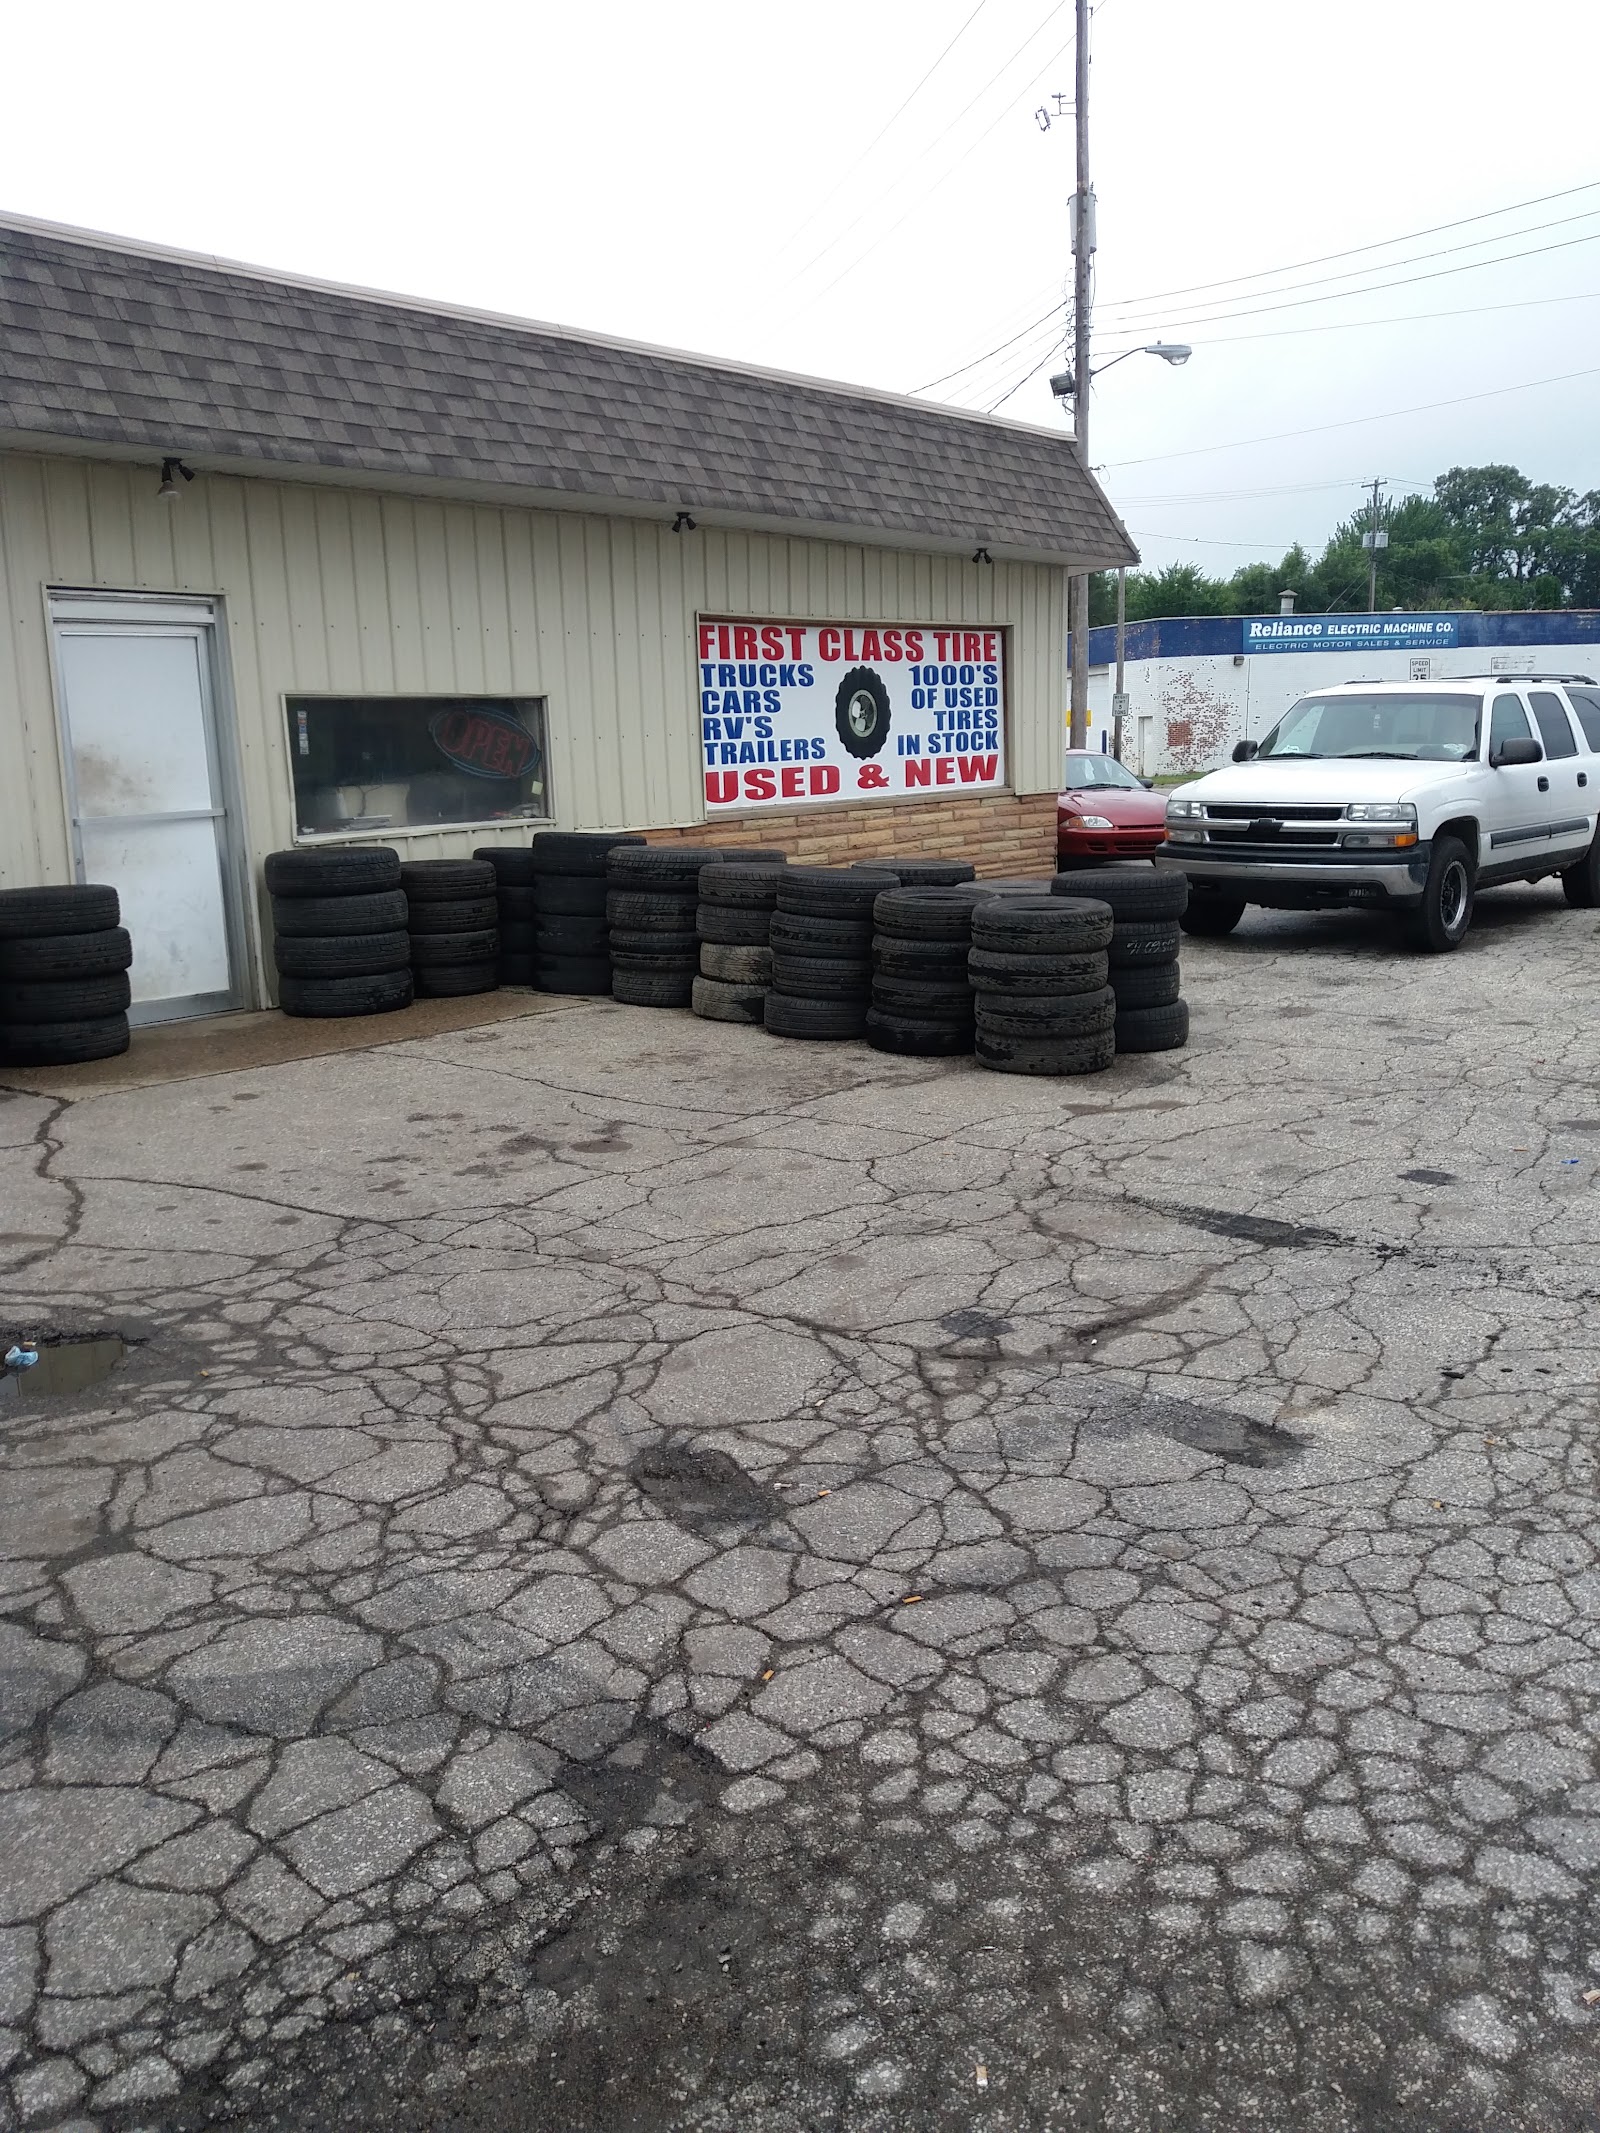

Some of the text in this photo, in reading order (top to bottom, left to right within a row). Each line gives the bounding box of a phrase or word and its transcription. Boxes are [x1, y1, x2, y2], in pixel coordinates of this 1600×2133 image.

[1249, 621, 1454, 637] Reliance ELECTRIC MACHINE CO.
[700, 625, 997, 662] FIRST CLASS TIRE
[1255, 642, 1308, 650] ELECTRIC
[1405, 638, 1449, 646] SERVICE
[701, 664, 815, 688] TRUCKS
[908, 665, 998, 687] 1000'S
[702, 690, 781, 715] CARS
[911, 687, 998, 710] OF USED
[703, 716, 773, 741] RV'S
[934, 709, 998, 731] TIRES
[704, 738, 826, 765] TRAILERS
[897, 730, 999, 756] IN STOCK
[705, 754, 999, 804] USED & NEW
